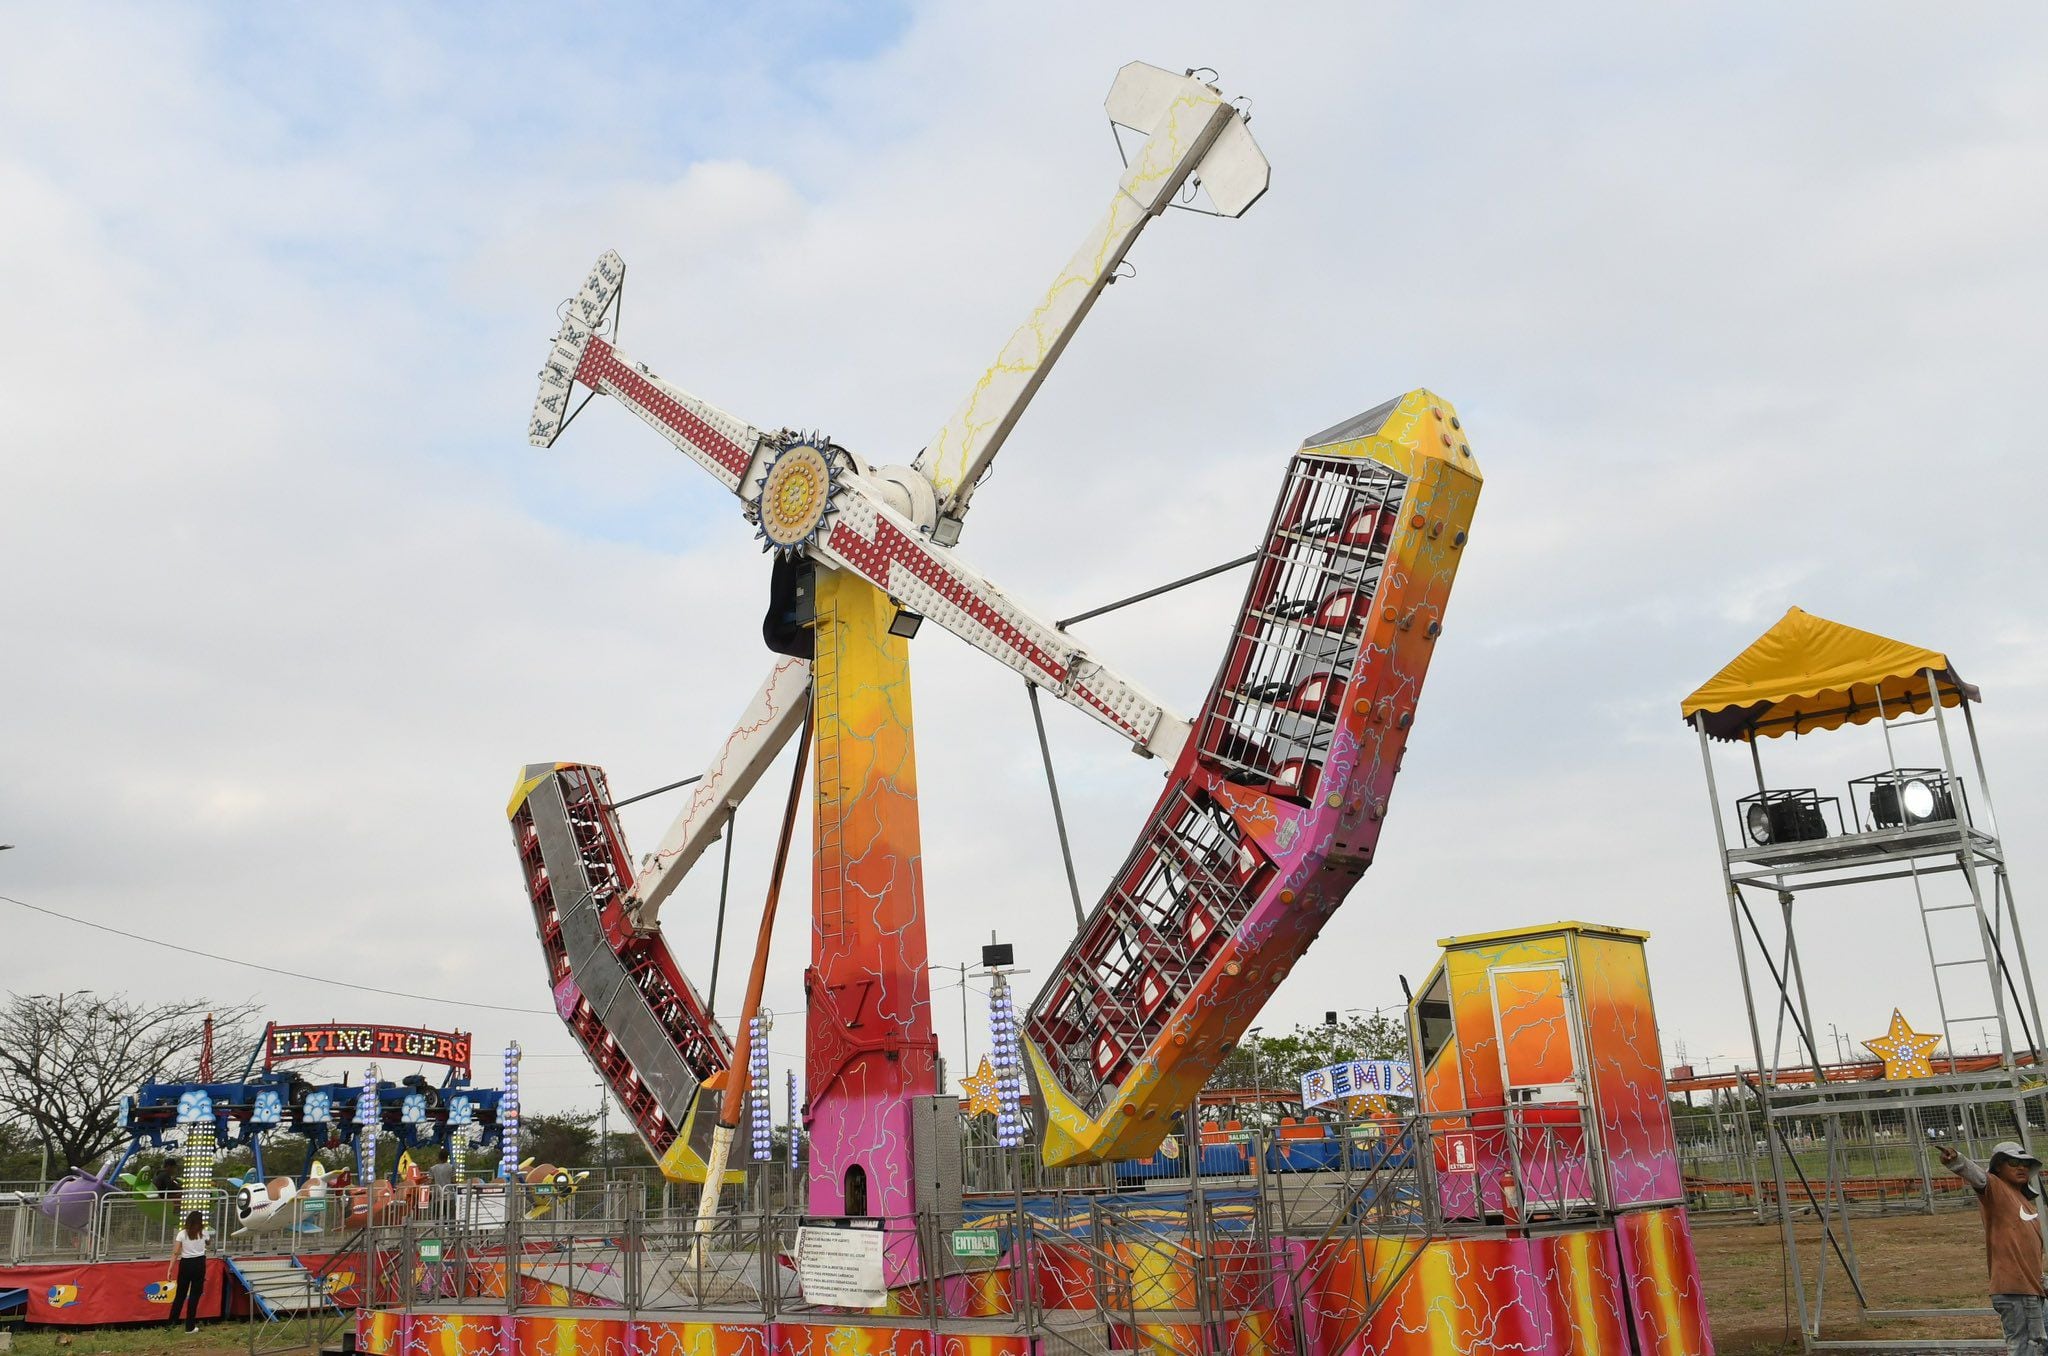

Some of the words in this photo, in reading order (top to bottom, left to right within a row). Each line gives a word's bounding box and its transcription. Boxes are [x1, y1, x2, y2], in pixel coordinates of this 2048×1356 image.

[532, 262, 617, 437] KAMIKAZE
[273, 1030, 373, 1054] FLYING
[378, 1032, 467, 1062] TIGERS
[1308, 1063, 1414, 1100] REMIX
[141, 1171, 149, 1181] 6
[421, 1245, 440, 1257] SALIDA
[955, 1236, 996, 1250] ENTRADA
